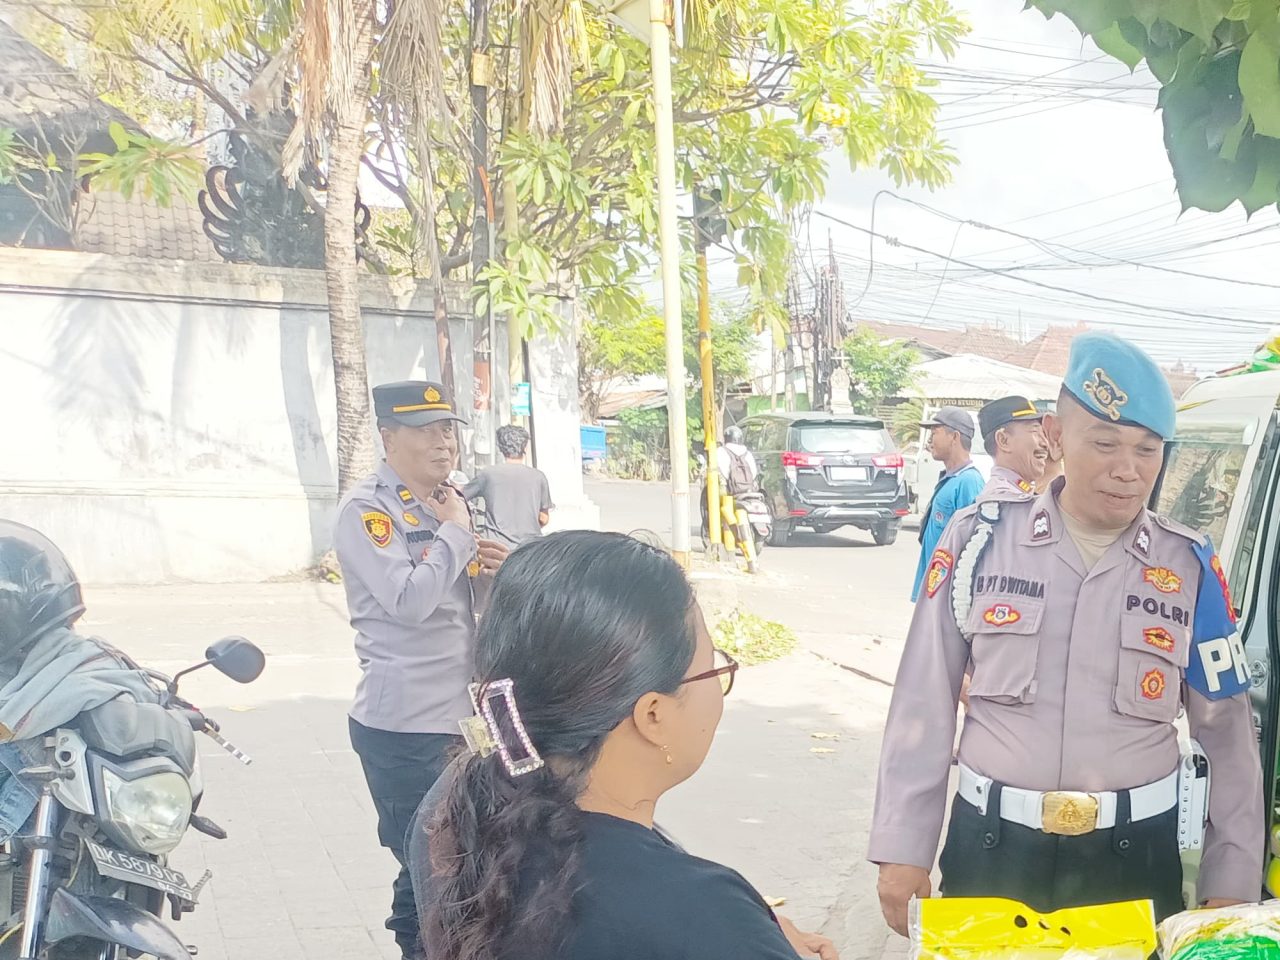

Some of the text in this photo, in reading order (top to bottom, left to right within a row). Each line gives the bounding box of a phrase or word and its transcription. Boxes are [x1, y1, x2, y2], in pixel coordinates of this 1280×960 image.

[1126, 594, 1189, 627] POLRI
[90, 842, 119, 866] DK
[117, 852, 164, 879] 5879
